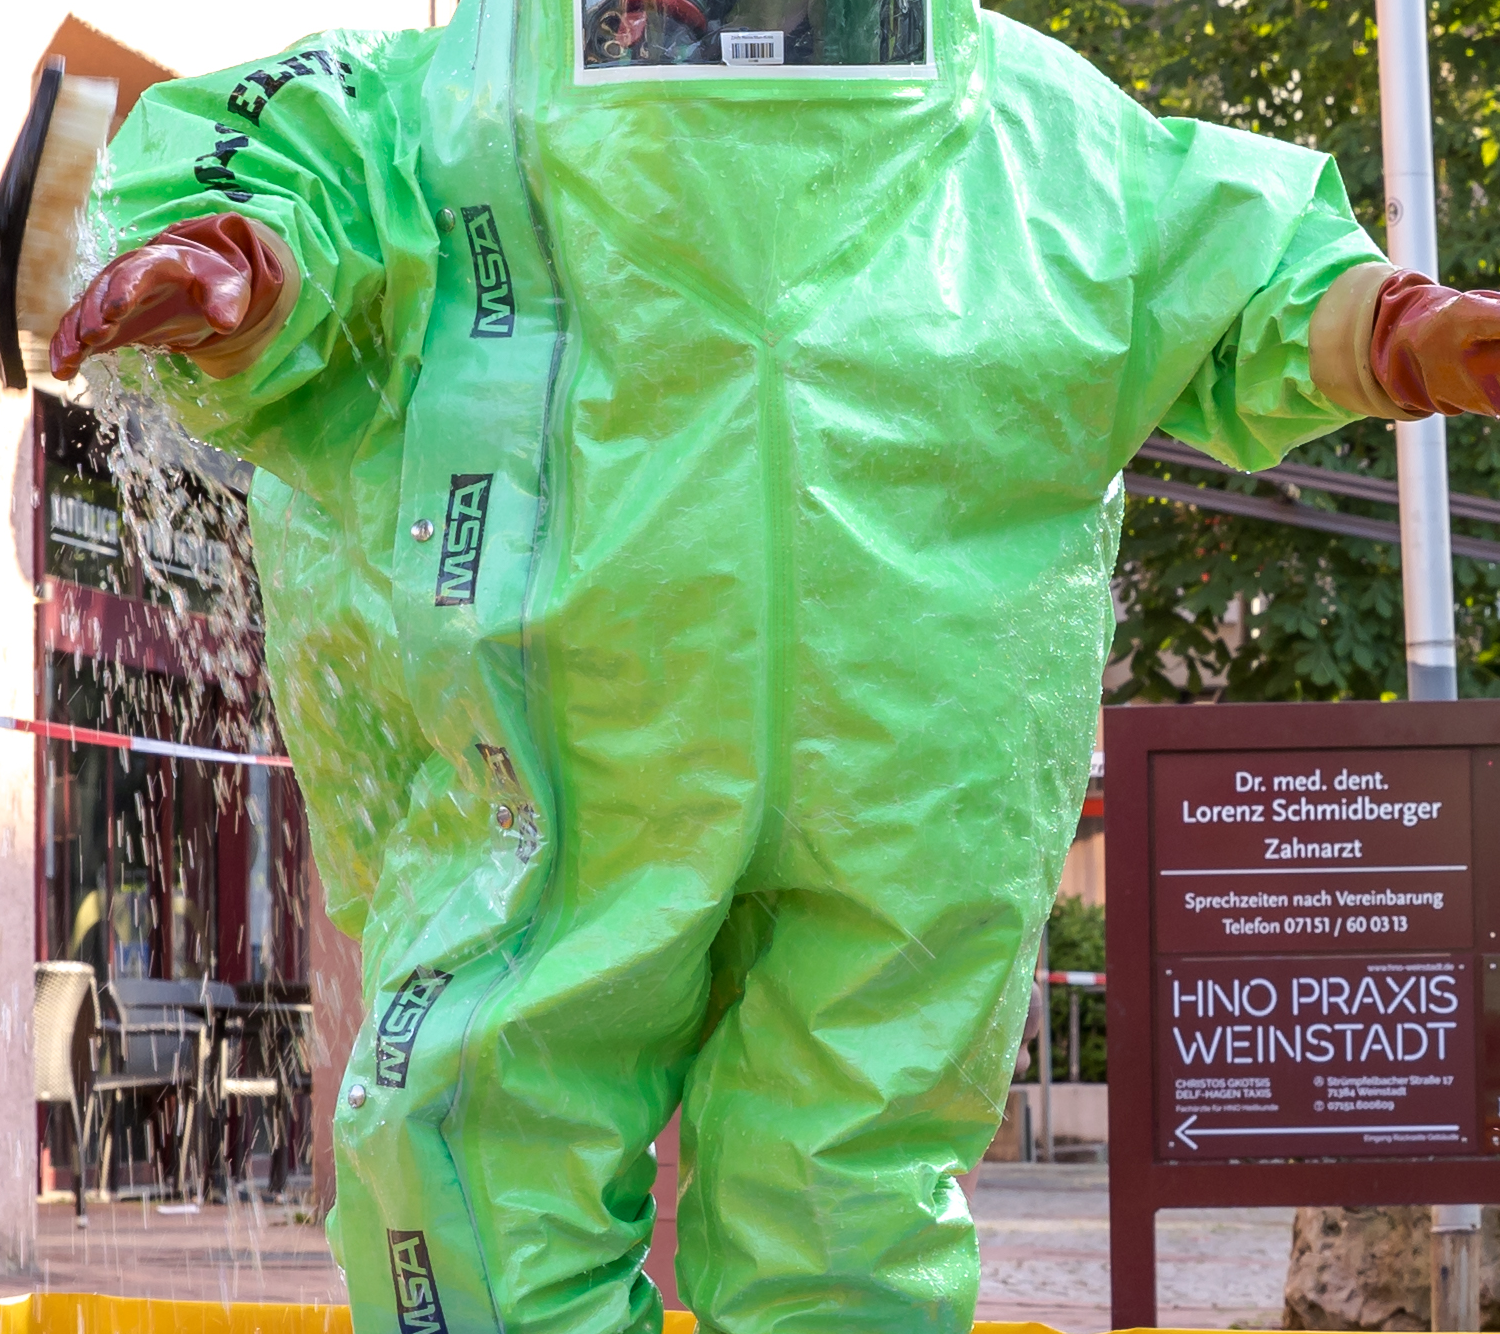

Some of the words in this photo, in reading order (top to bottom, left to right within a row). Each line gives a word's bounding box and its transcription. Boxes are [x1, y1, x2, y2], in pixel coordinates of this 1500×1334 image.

[464, 208, 513, 336] MSA
[437, 478, 489, 602] MSA
[1235, 771, 1266, 793] Dr.
[1273, 769, 1327, 791] med.
[1334, 768, 1389, 790] dent.
[1182, 800, 1265, 823] Lorenz
[1272, 796, 1442, 827] Schmidberger
[1263, 837, 1362, 859] Zahnarzt
[1184, 891, 1288, 913] Sprechzeiten
[1293, 890, 1332, 907] nach
[1335, 889, 1444, 909] Vereinbarung
[1222, 918, 1280, 935] Telefon
[1284, 917, 1330, 934] 07151
[1173, 978, 1277, 1018] HNO
[1292, 975, 1459, 1016] PRAXIS
[379, 968, 451, 1086] MSA
[1173, 1022, 1457, 1065] WEINSTADT
